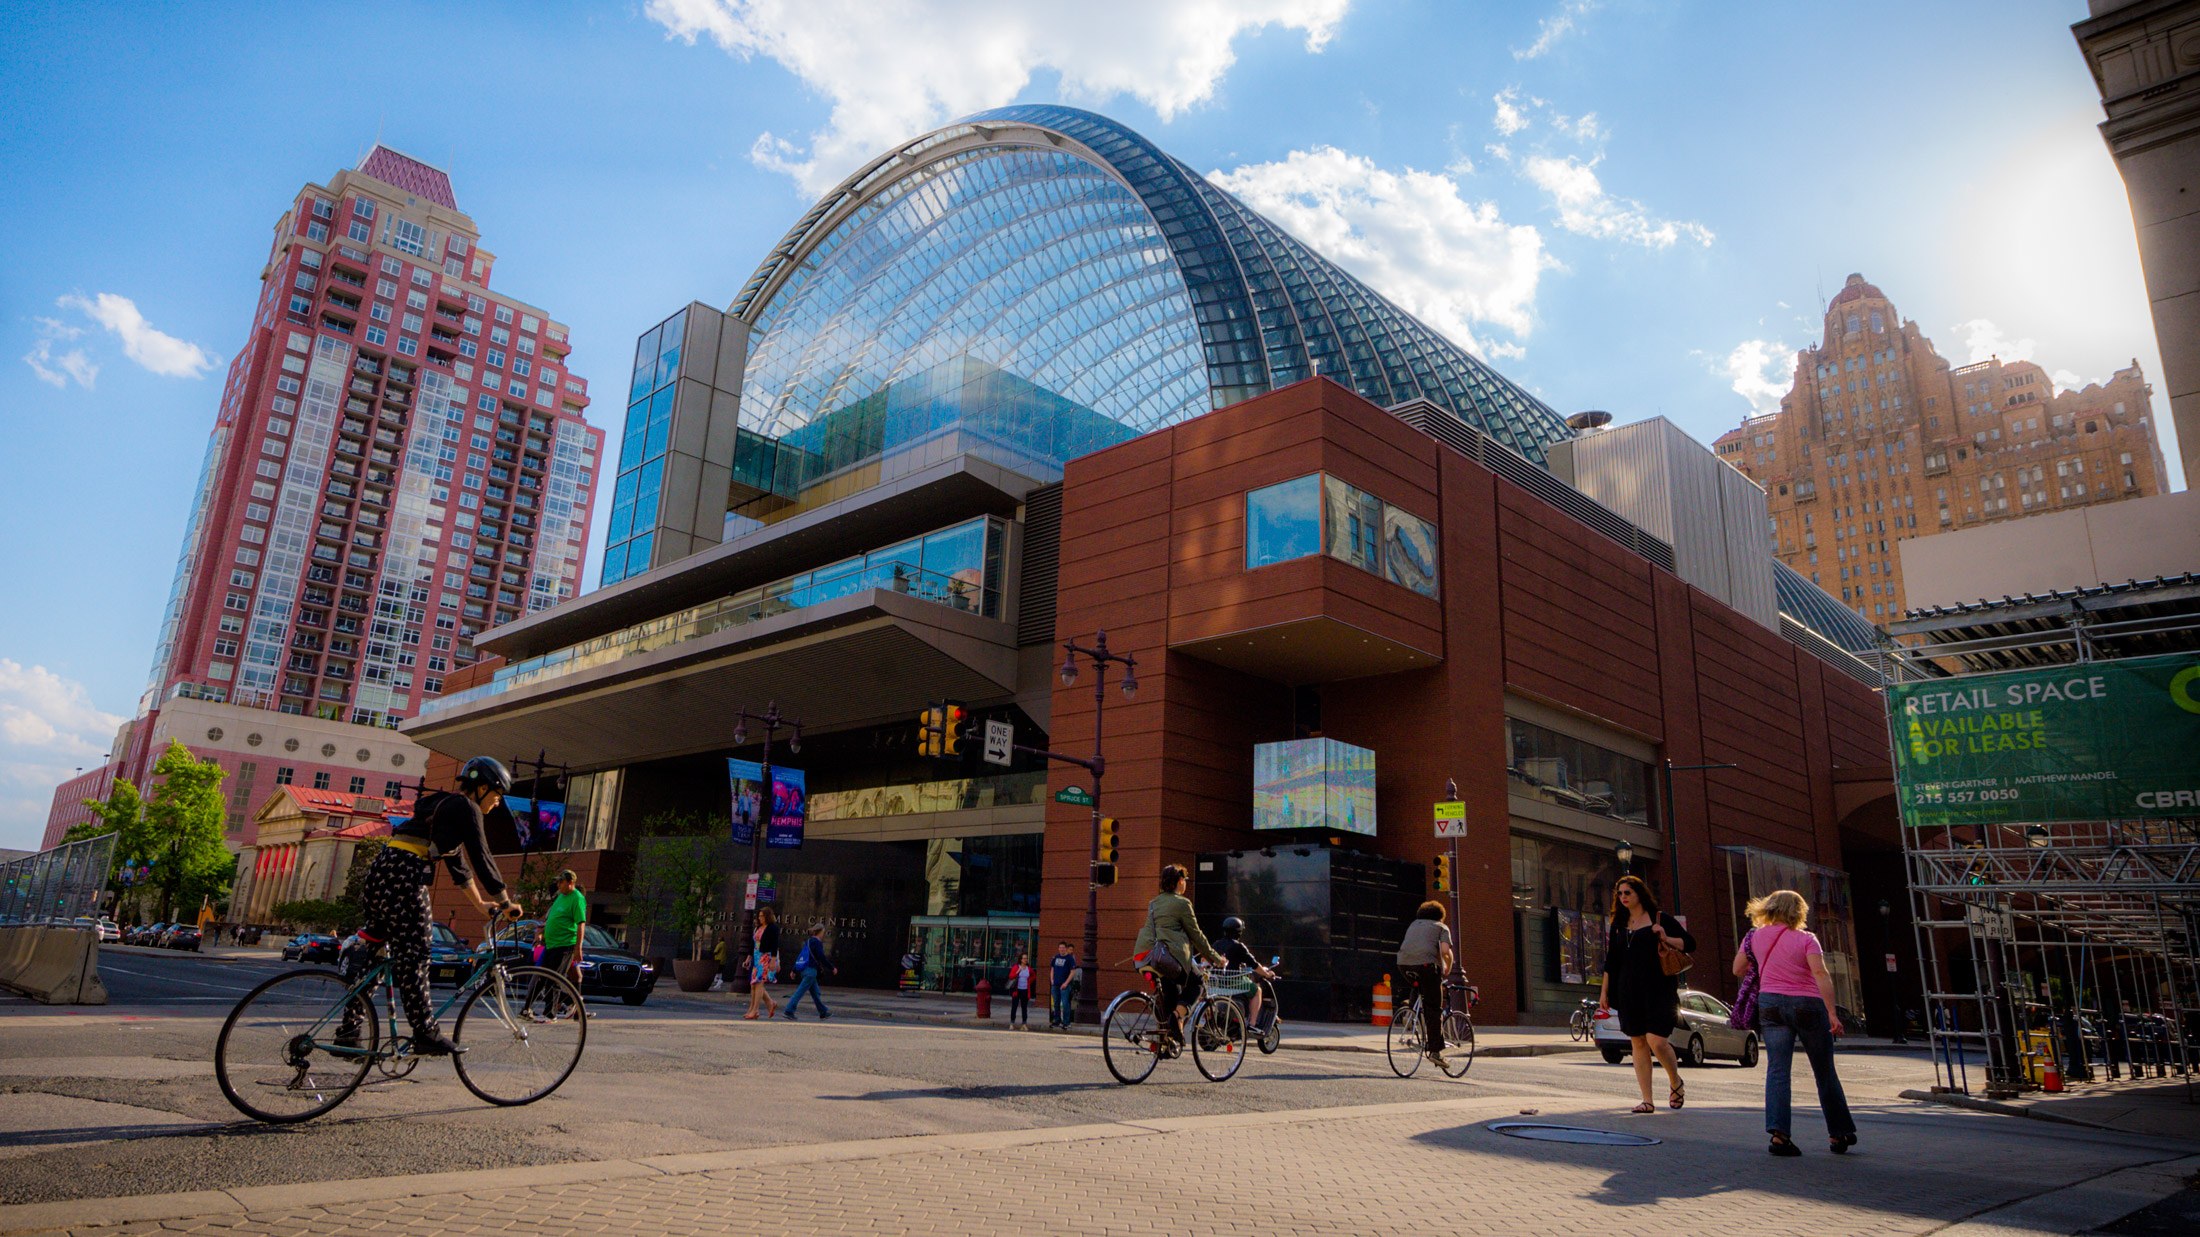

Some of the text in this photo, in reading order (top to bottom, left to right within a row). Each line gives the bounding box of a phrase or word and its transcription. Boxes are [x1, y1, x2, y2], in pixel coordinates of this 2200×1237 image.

[1906, 676, 2107, 715] RETAIL SPACE
[991, 724, 1007, 736] ONE
[1908, 710, 2045, 739] AVAILABLE
[990, 736, 1008, 747] WAY
[1910, 730, 2047, 758] FOR LEASE
[1914, 771, 2118, 791] STEVEN GARTNER MATTHEW MANDEL
[1060, 794, 1080, 803] SPRUCE
[1916, 788, 2019, 804] 215 557 0050
[771, 816, 803, 826] MEMPHIS
[711, 912, 736, 922] THE
[808, 915, 867, 928] CENTER
[839, 931, 867, 939] ARTS
